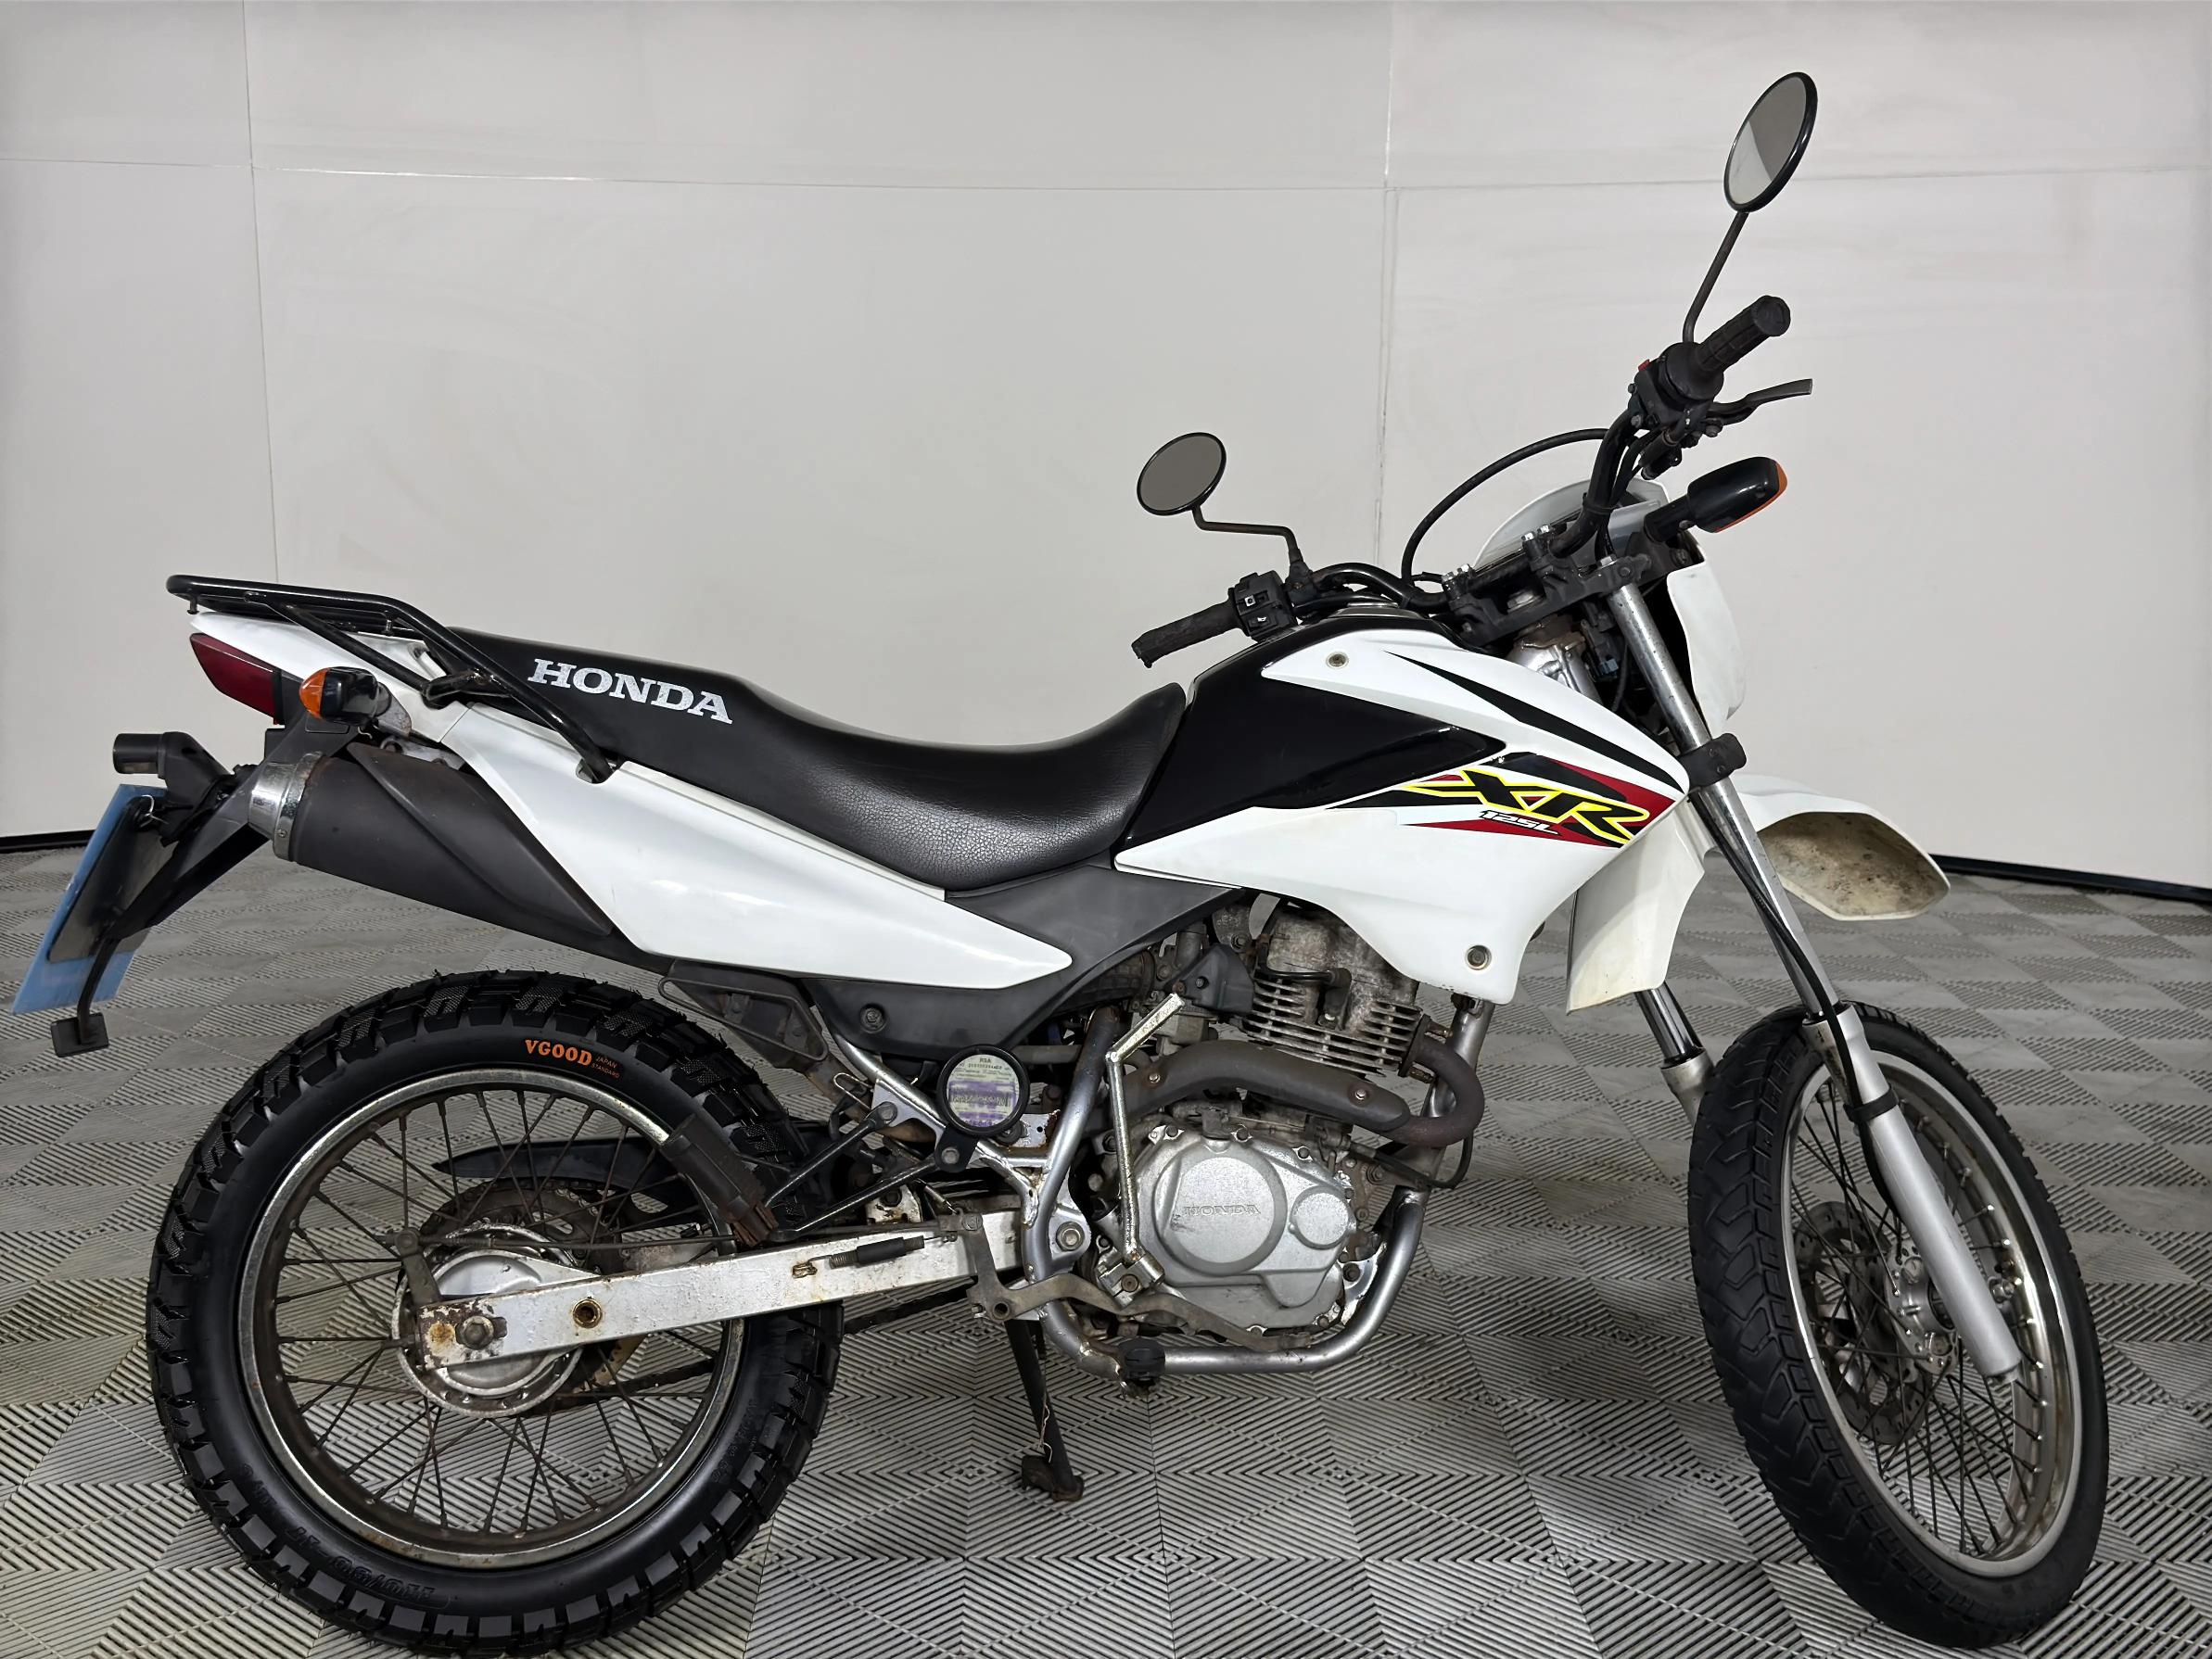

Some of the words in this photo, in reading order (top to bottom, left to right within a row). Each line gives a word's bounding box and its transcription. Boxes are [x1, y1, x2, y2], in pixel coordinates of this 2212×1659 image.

[528, 658, 732, 725] HONDA
[1398, 769, 1650, 845] XR
[1479, 809, 1560, 835] 125L
[525, 1039, 592, 1066] VGOOD
[595, 1056, 617, 1069] JAPAN
[1184, 1204, 1262, 1217] HONDA
